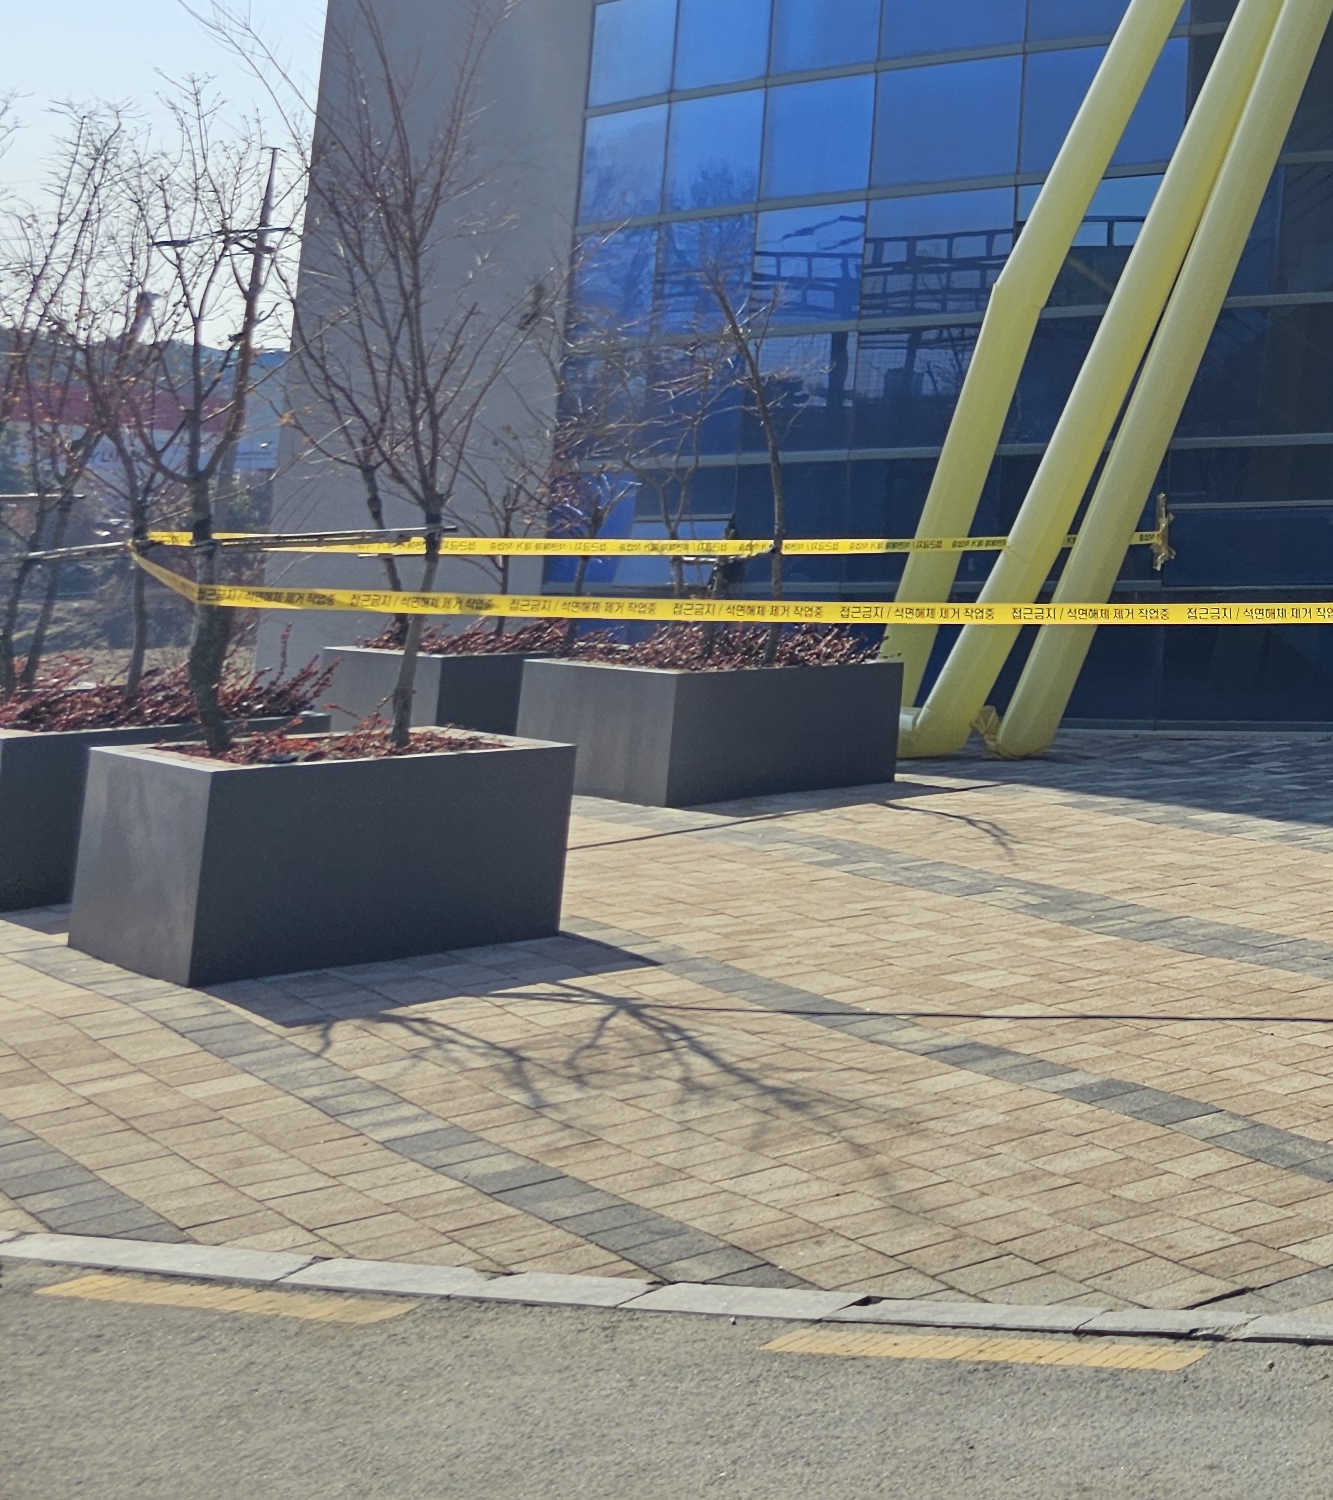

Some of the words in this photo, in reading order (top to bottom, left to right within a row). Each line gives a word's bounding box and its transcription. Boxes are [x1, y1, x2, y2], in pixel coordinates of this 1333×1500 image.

[509, 599, 551, 612] 접근금지
[627, 602, 657, 615] 작업중
[673, 603, 715, 616] 접근금지
[794, 606, 823, 618] 작업중
[840, 606, 883, 619] 접근금지
[964, 607, 995, 620] 작업중
[1012, 607, 1056, 620] 접근금지
[1138, 608, 1170, 621] 작업중
[1187, 607, 1232, 620] 접근금지
